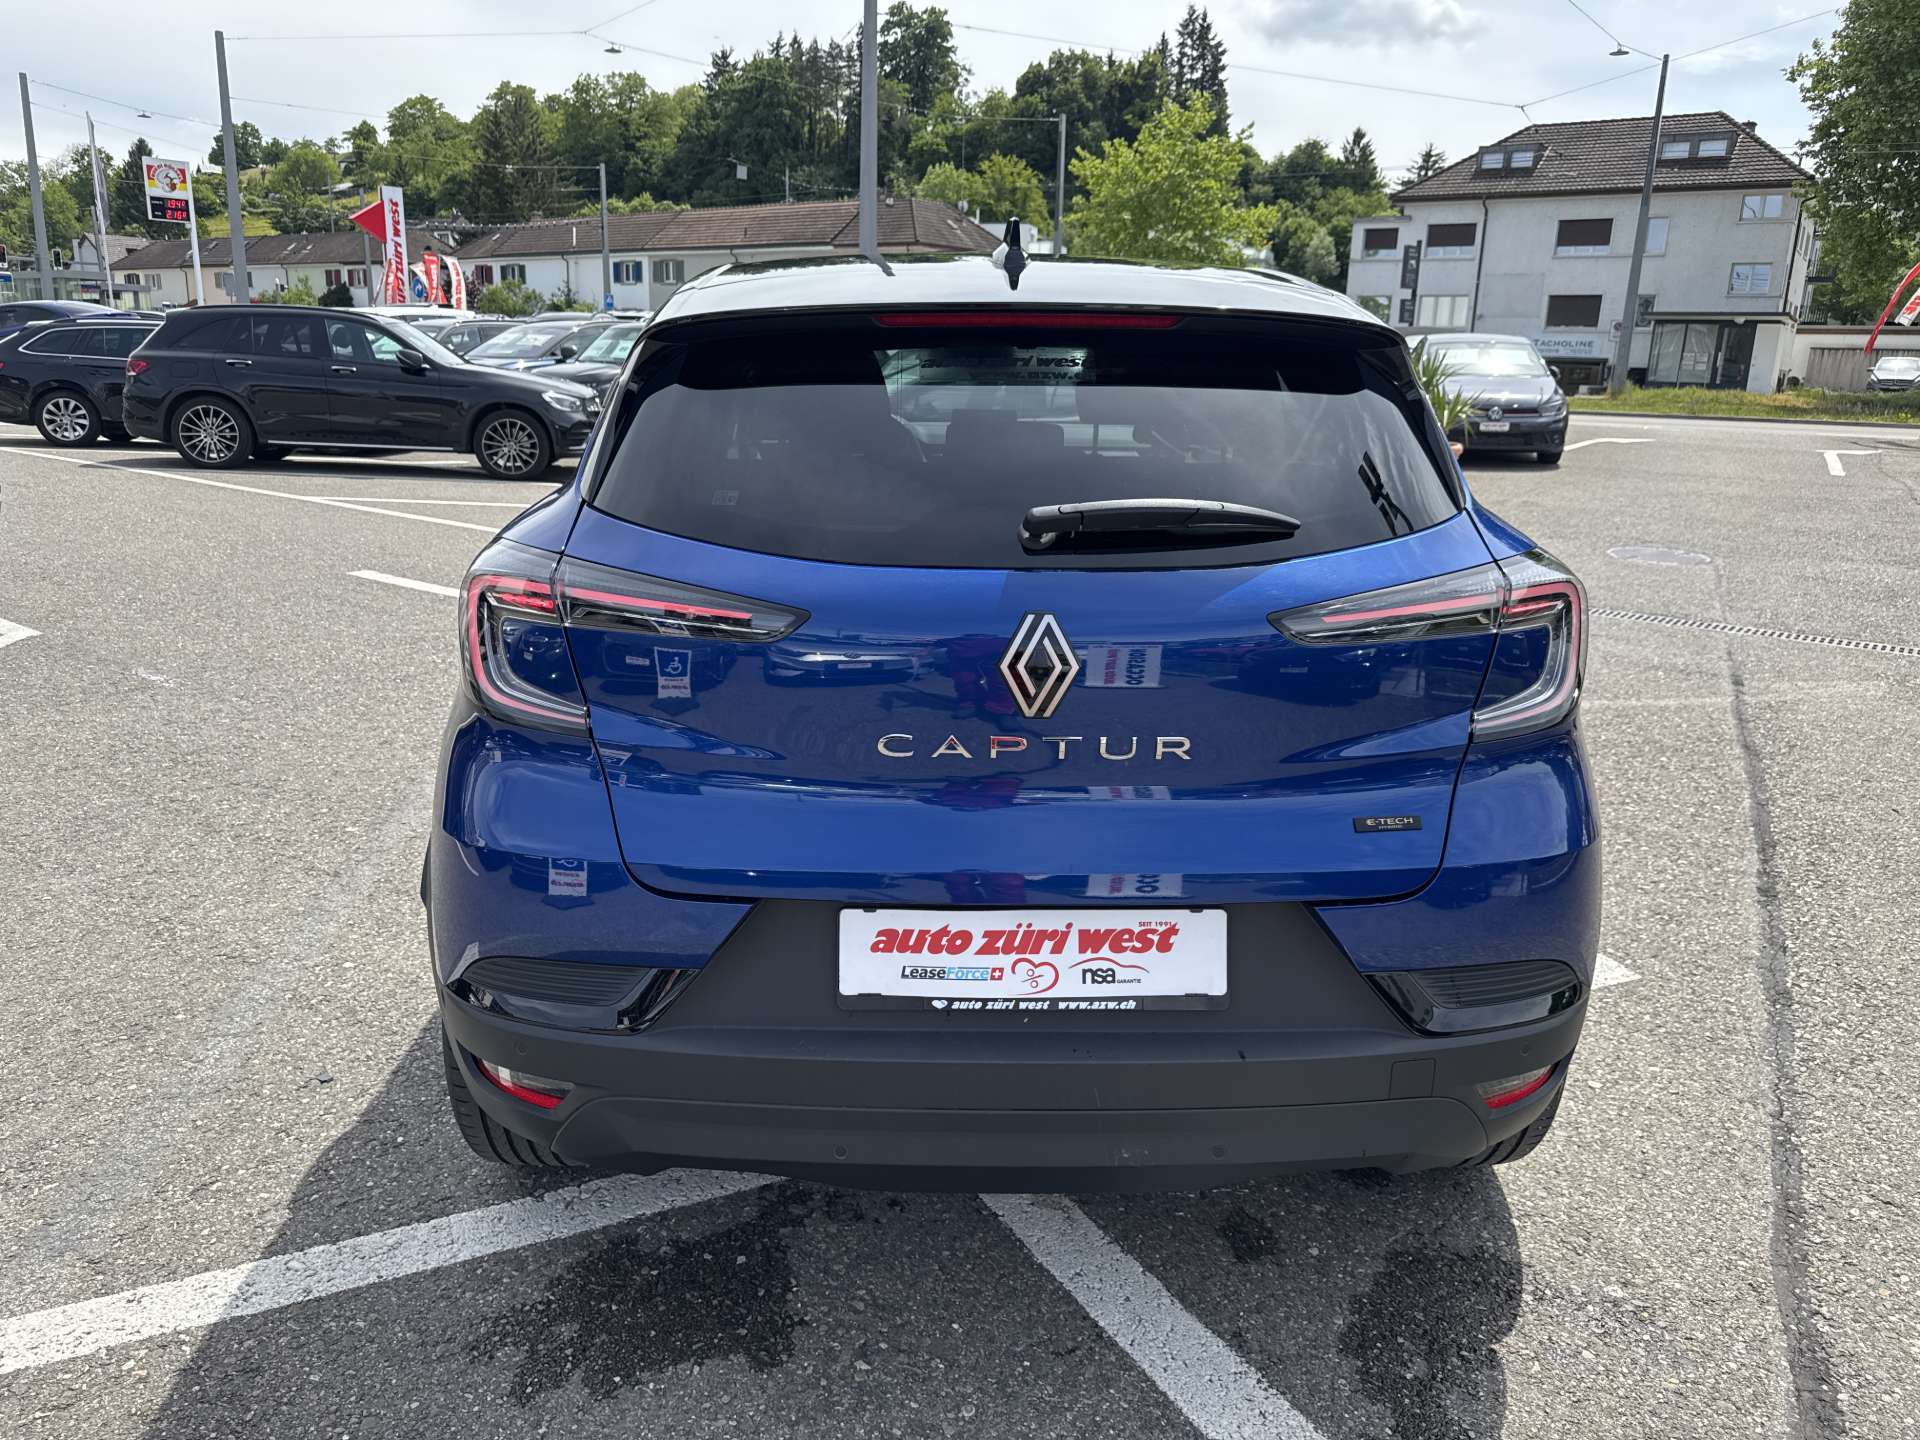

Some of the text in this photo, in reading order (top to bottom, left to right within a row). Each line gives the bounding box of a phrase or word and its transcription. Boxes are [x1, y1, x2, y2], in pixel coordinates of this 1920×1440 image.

[388, 198, 402, 238] west
[1533, 338, 1595, 348] TACHOLINE
[877, 733, 1192, 760] CAPTUR
[869, 921, 1181, 955] auto züri west
[901, 965, 990, 980] LeaseForce
[1082, 967, 1116, 984] nsa
[951, 999, 1137, 1010] auto züri west www.azw.ch
